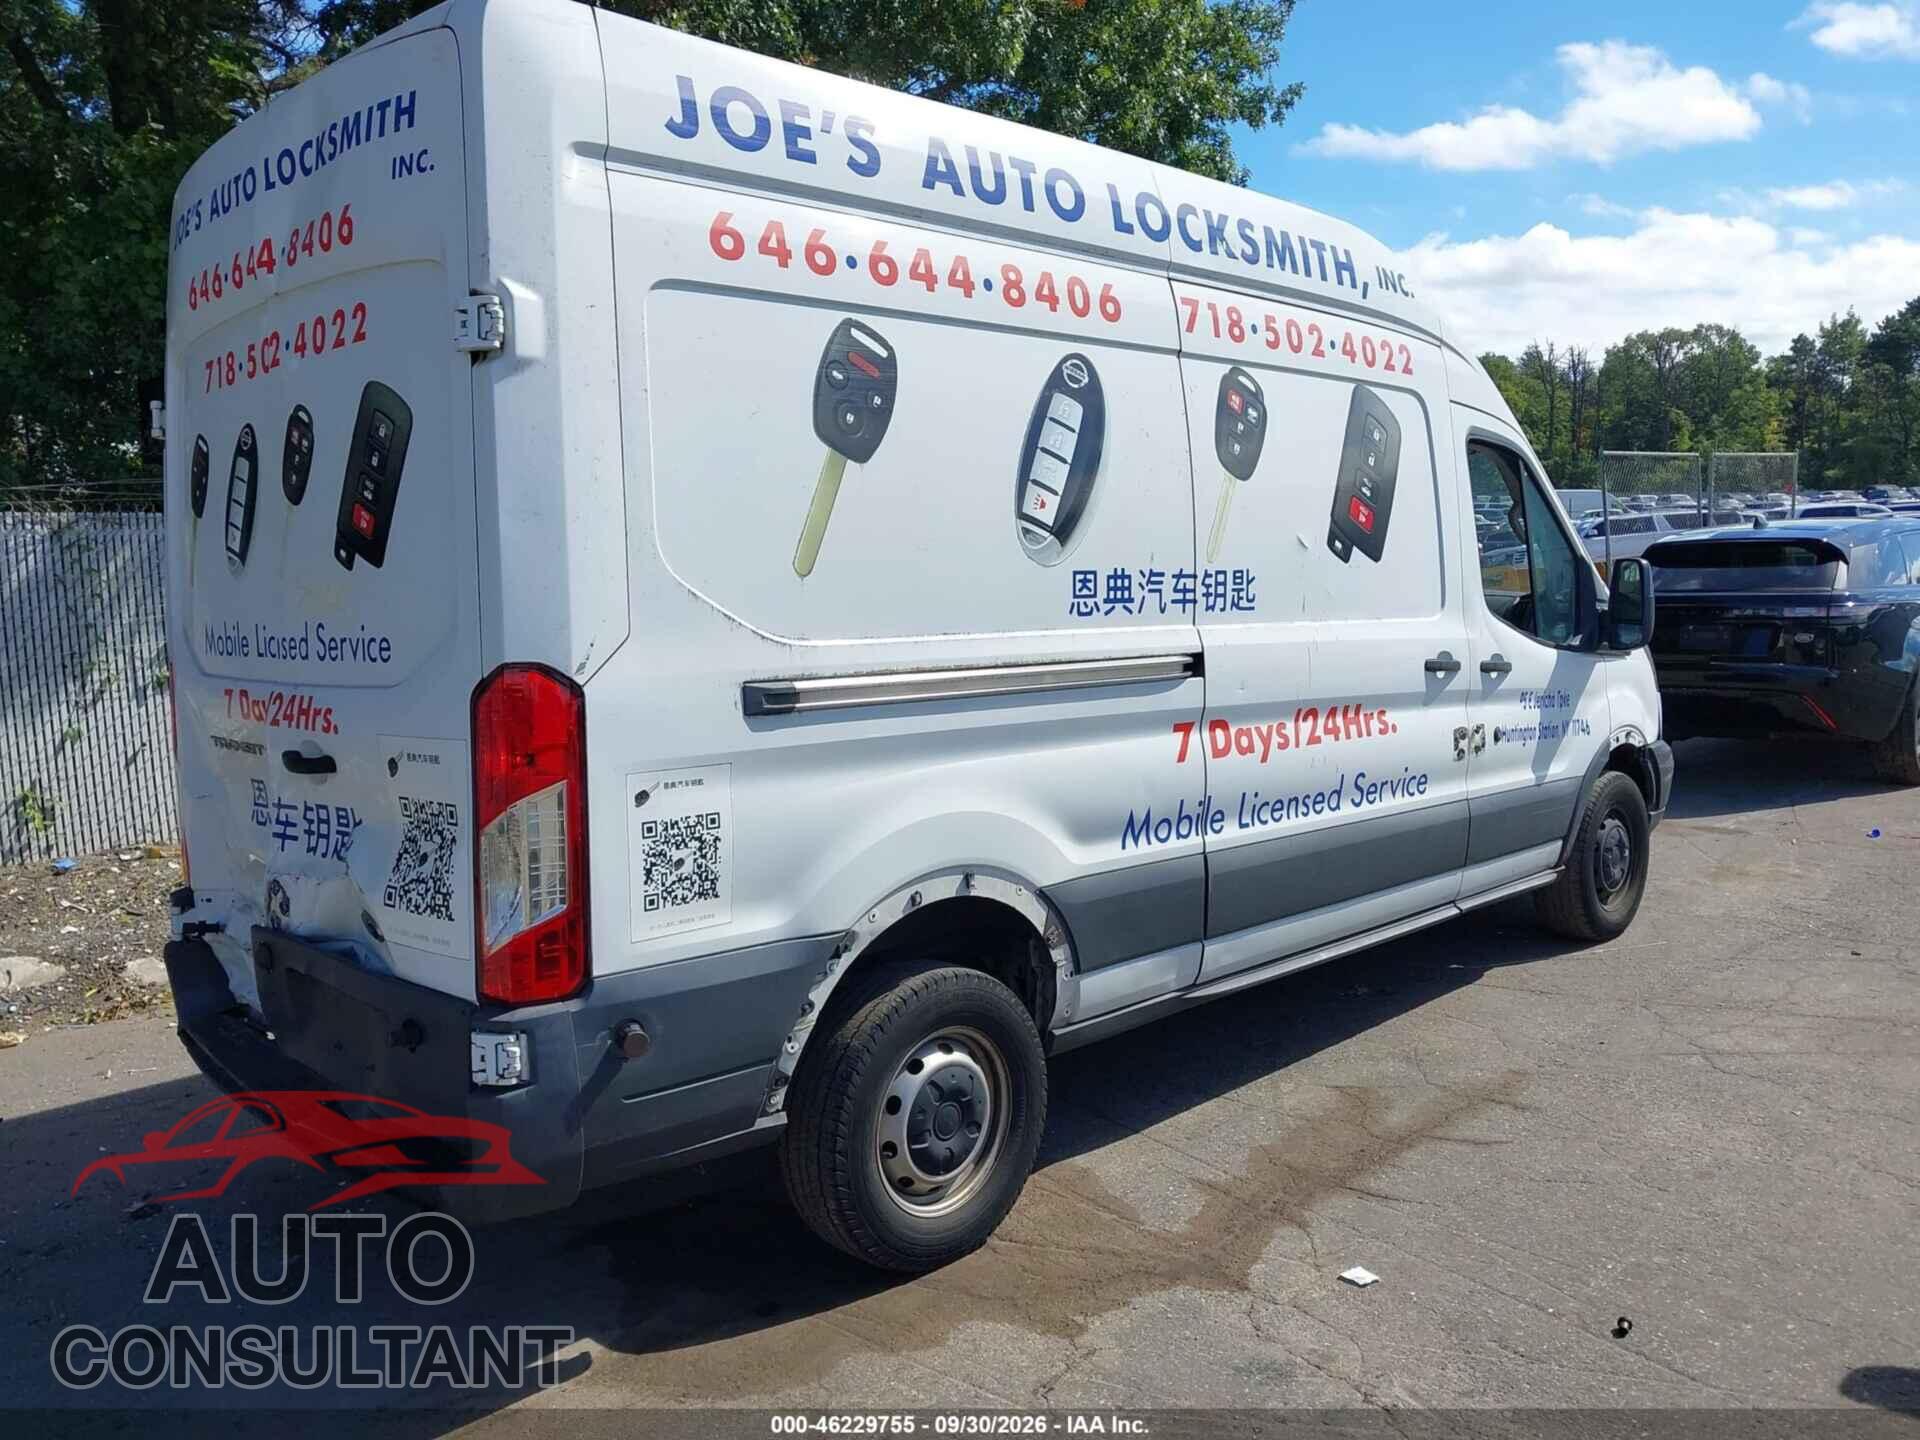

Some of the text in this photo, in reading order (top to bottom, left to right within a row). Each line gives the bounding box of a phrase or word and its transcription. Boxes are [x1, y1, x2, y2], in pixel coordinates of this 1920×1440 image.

[208, 166, 257, 224] AUTO
[263, 90, 417, 192] LOCKSMITH
[391, 148, 435, 180] INC.
[664, 74, 1416, 300] JOE'S AUTO LOCKSMITH, INC.
[1069, 567, 1257, 617] 恩典汽车钥匙
[204, 622, 250, 657] Mobile
[316, 623, 392, 663] Service
[223, 688, 234, 718] 7
[1172, 721, 1196, 763] 7
[1121, 766, 1429, 851] Mobile Licensed Service
